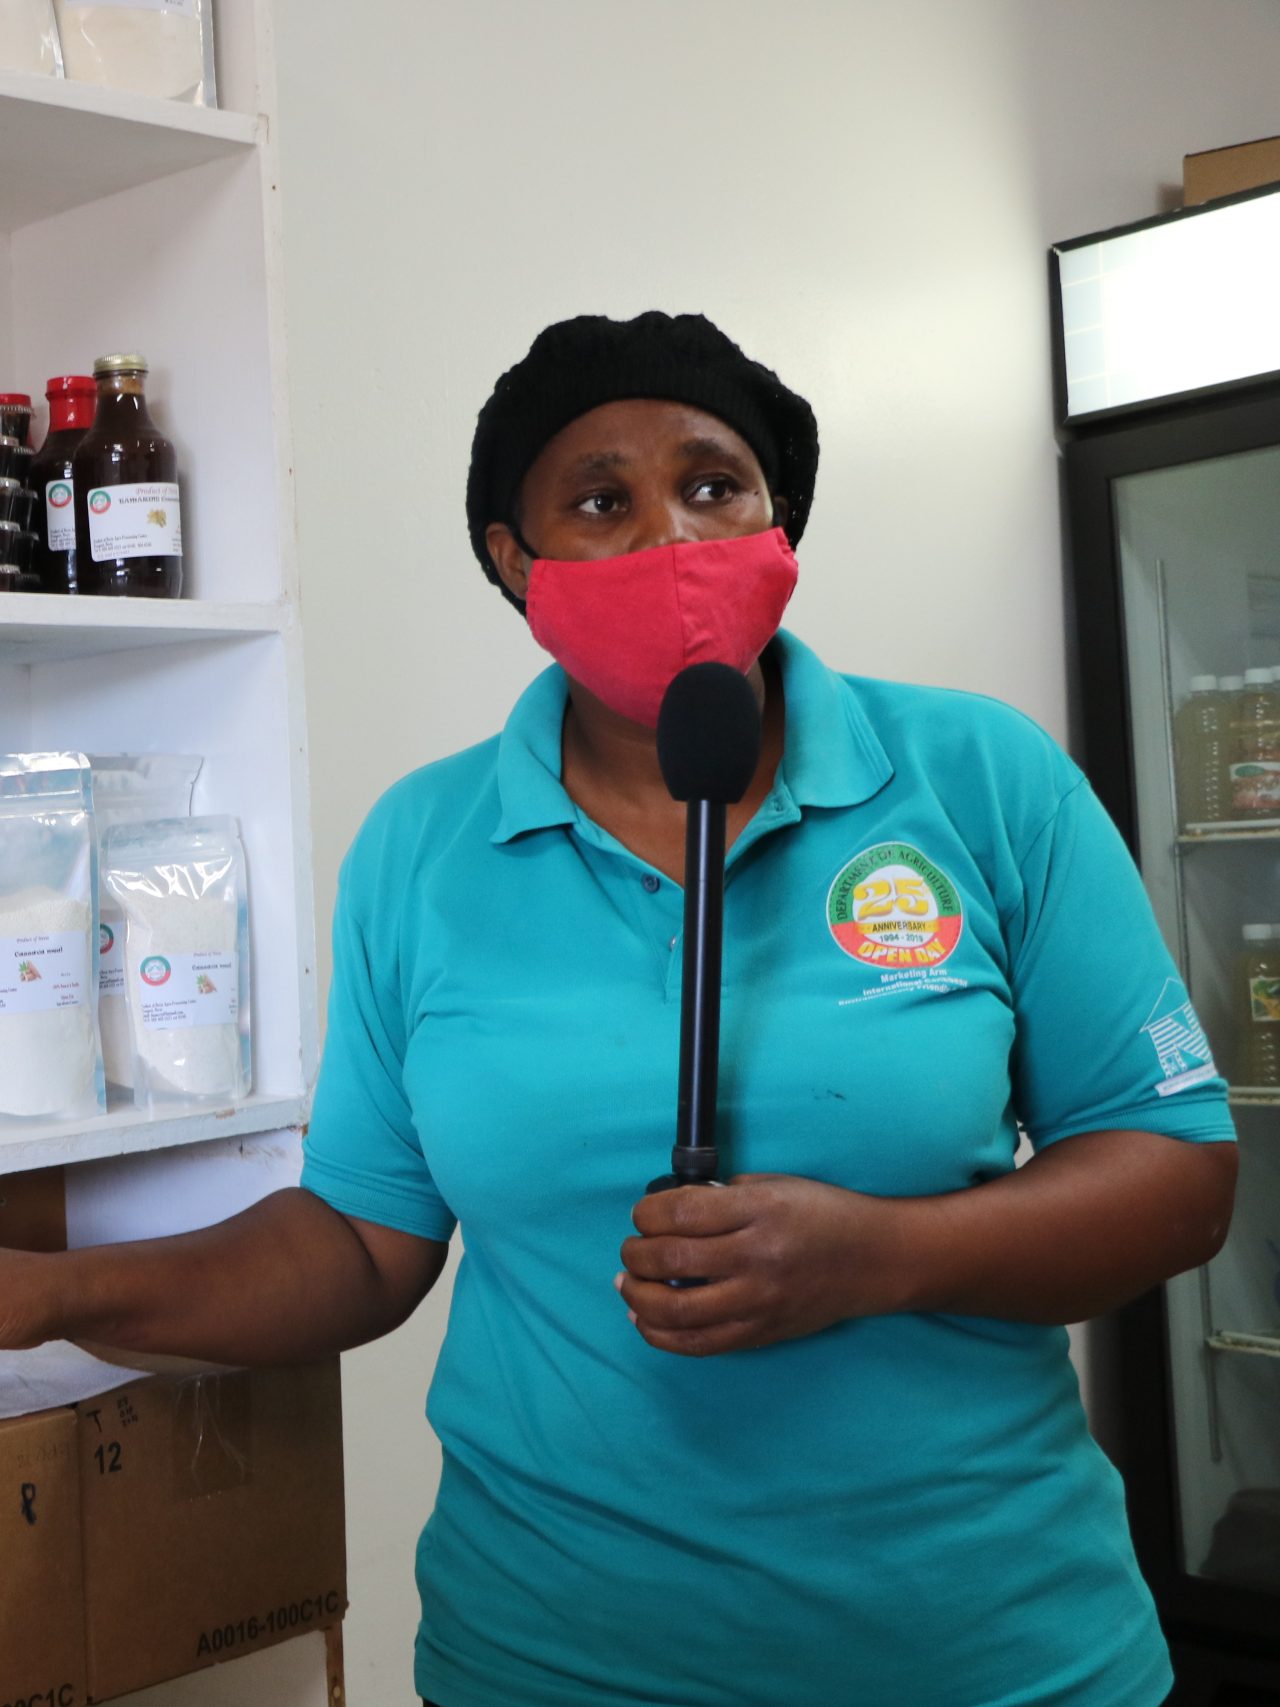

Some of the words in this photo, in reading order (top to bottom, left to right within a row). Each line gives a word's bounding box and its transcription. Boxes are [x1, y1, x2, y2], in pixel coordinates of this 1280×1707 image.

[836, 853, 875, 921] DEPARTMENT
[898, 850, 954, 912] AGRICULTURE
[852, 877, 930, 921] 25
[872, 921, 926, 932] ANNIVERSARY
[880, 934, 900, 943] 1994
[857, 941, 913, 963] OPEN
[914, 938, 947, 963] DAY
[863, 980, 922, 997] International
[880, 969, 927, 984] Marketing
[929, 968, 947, 977] Arm
[94, 1441, 122, 1474] 12
[196, 1590, 341, 1658] A0016-100C1C
